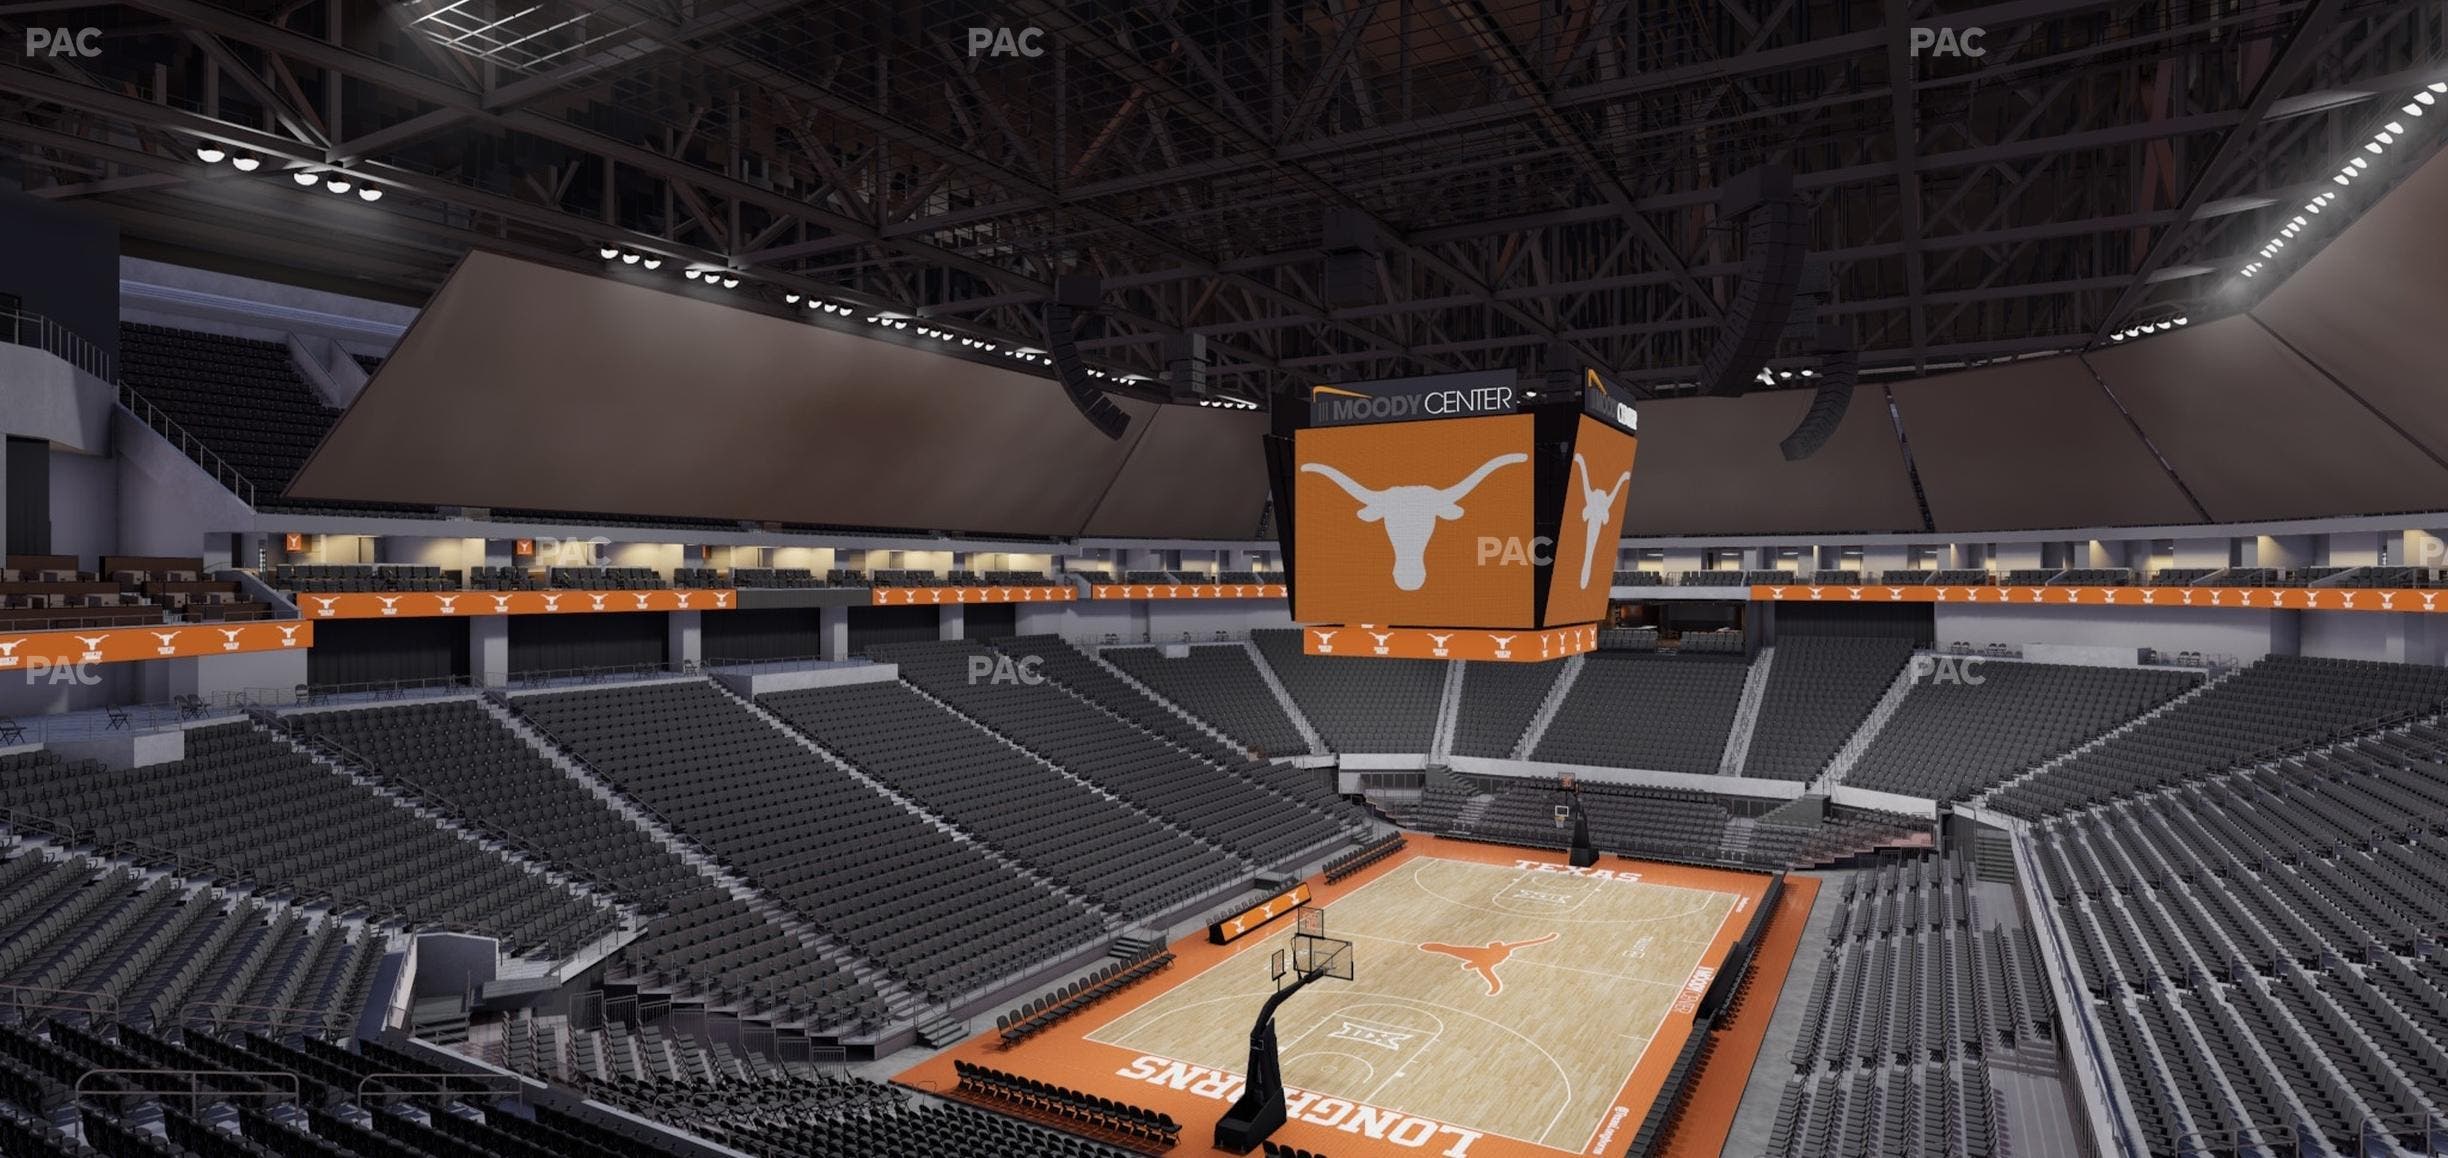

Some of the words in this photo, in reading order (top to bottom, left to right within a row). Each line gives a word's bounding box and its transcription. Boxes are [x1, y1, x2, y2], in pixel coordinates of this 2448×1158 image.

[1333, 394, 1423, 421] MOODY
[1424, 387, 1514, 415] CENTER
[1514, 860, 1642, 882] TEXAS
[1115, 1055, 1483, 1158] LONGHRNS
